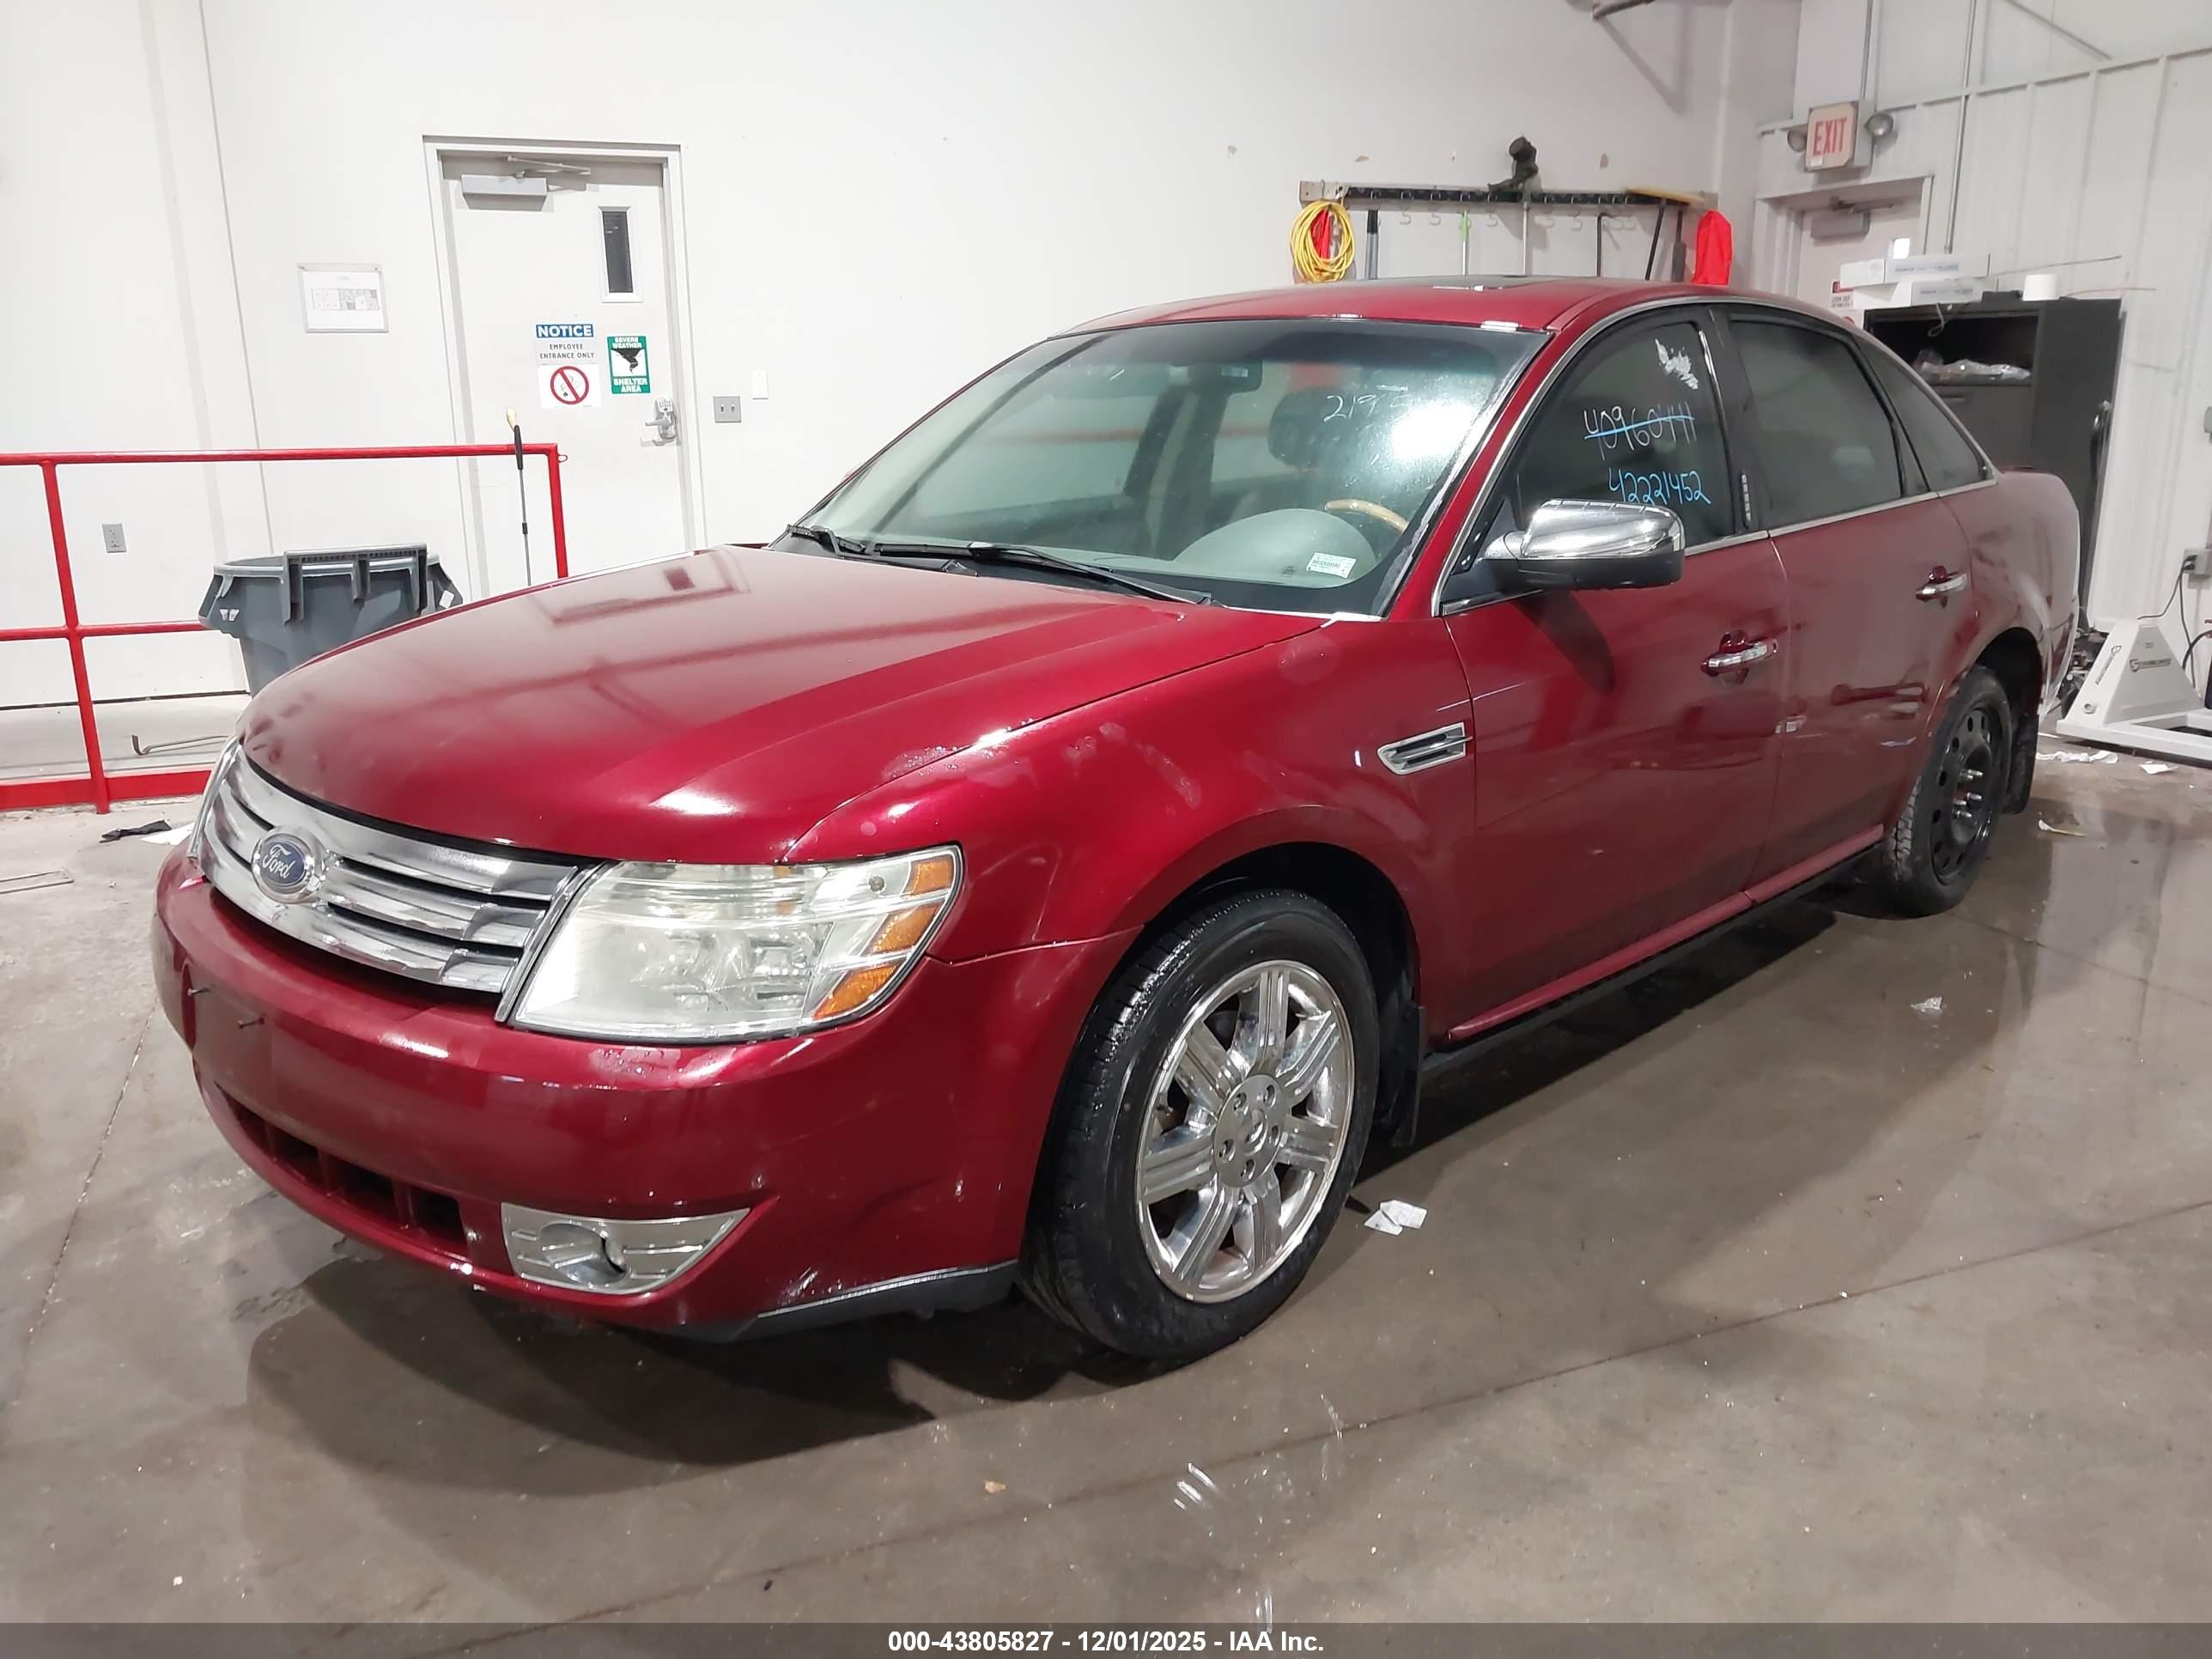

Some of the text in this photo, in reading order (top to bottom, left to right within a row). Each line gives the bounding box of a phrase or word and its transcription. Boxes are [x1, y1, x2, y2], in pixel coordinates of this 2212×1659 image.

[1813, 117, 1847, 155] EXIT
[538, 325, 592, 337] NOTICE
[1608, 467, 1711, 506] 42221452
[262, 844, 296, 879] Ford
